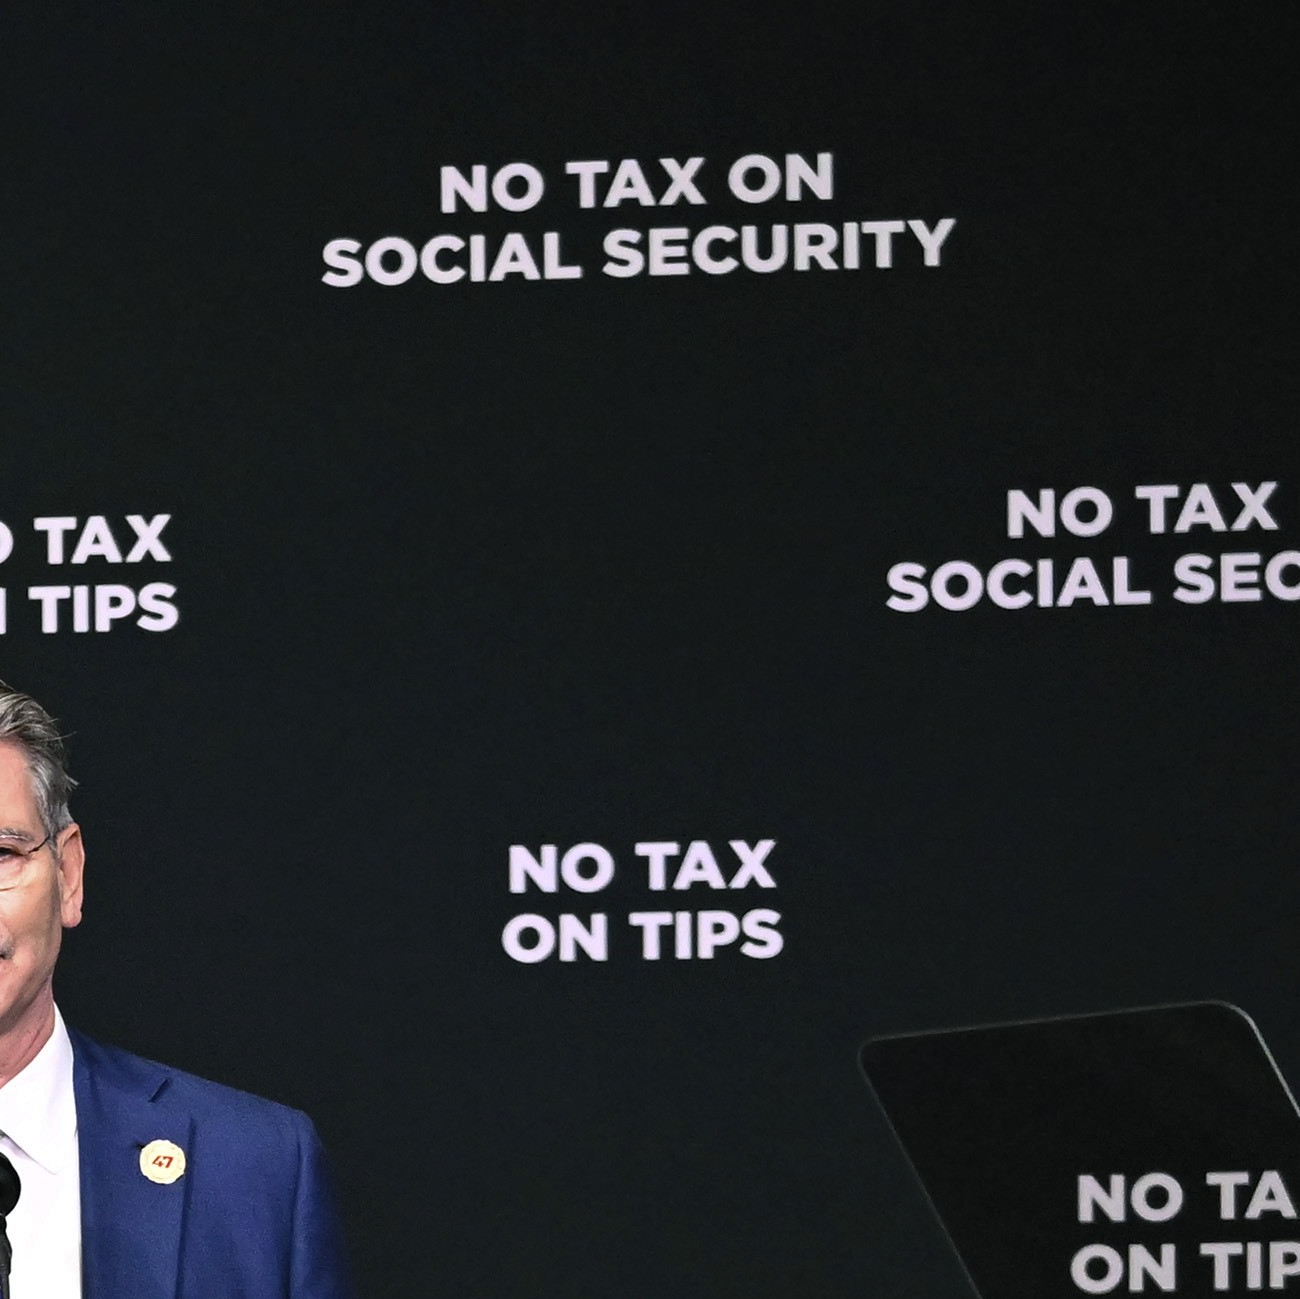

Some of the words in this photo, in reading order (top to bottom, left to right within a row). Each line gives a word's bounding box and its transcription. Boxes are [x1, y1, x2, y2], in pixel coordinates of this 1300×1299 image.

[440, 162, 544, 214] NO
[565, 157, 706, 209] TAX
[728, 152, 833, 204] ON
[321, 231, 582, 288] SOCIAL
[602, 218, 956, 278] SECURITY
[1007, 486, 1113, 539] NO
[1135, 481, 1279, 534] TAX
[33, 513, 172, 565] TAX
[27, 582, 179, 634] TIPS
[886, 556, 1152, 613] SOCIAL
[509, 842, 615, 894] NO
[634, 839, 777, 891] TAX
[501, 912, 608, 964] ON
[628, 908, 784, 961] TIPS
[151, 1154, 174, 1169] 47
[1078, 1172, 1183, 1222] NO
[1070, 1243, 1176, 1294] ON
